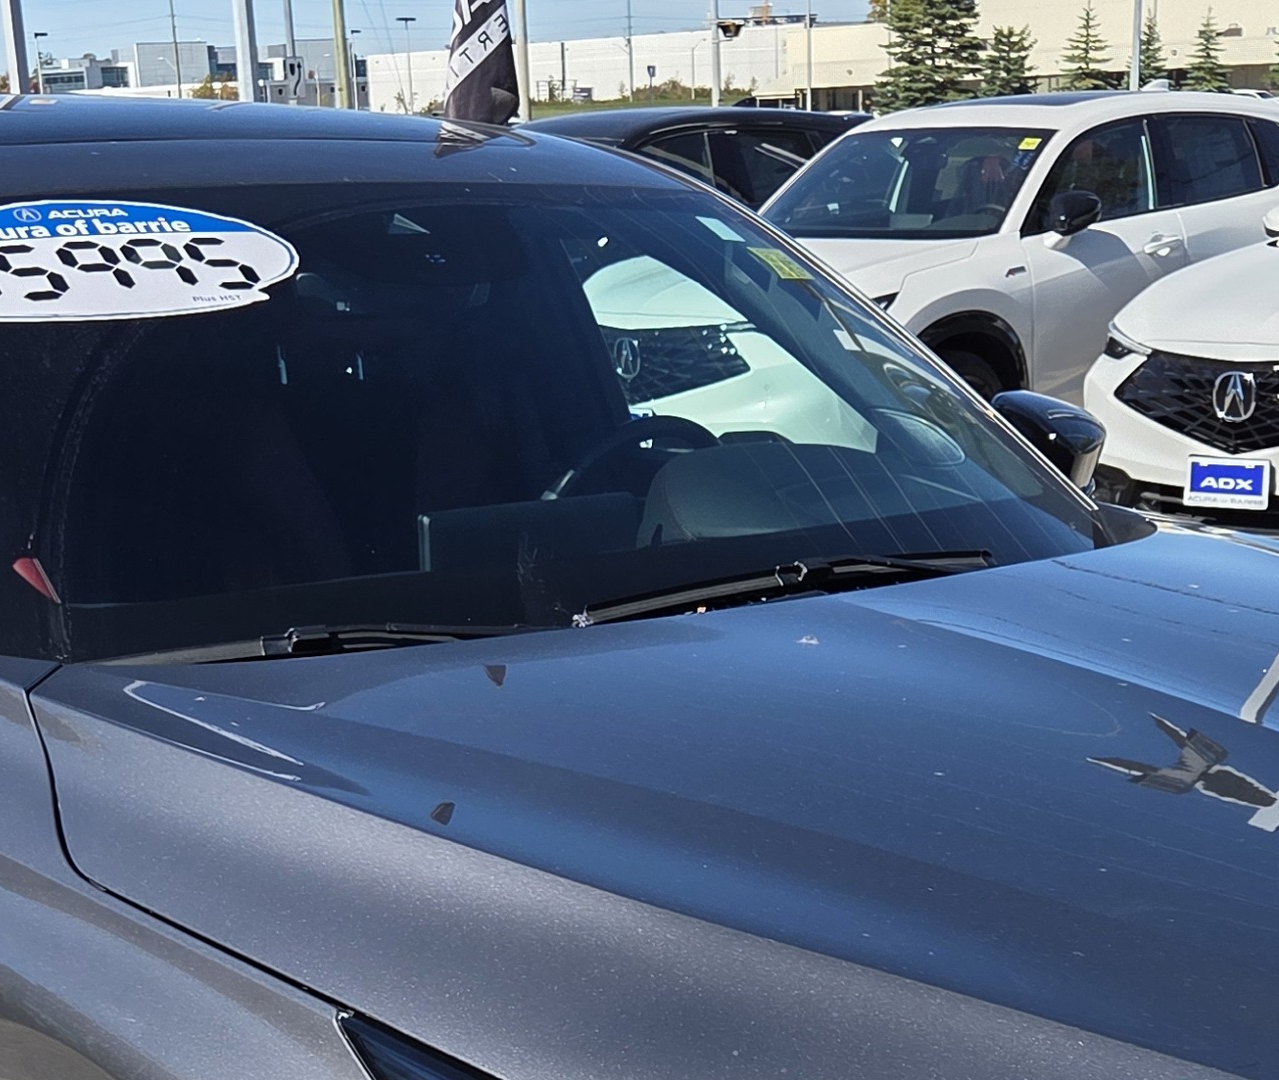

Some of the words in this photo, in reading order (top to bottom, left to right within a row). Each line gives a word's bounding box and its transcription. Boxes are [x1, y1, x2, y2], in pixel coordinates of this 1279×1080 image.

[48, 208, 129, 220] ACURA
[55, 219, 89, 237] of
[92, 217, 191, 236] barrie
[1200, 476, 1253, 491] ADX
